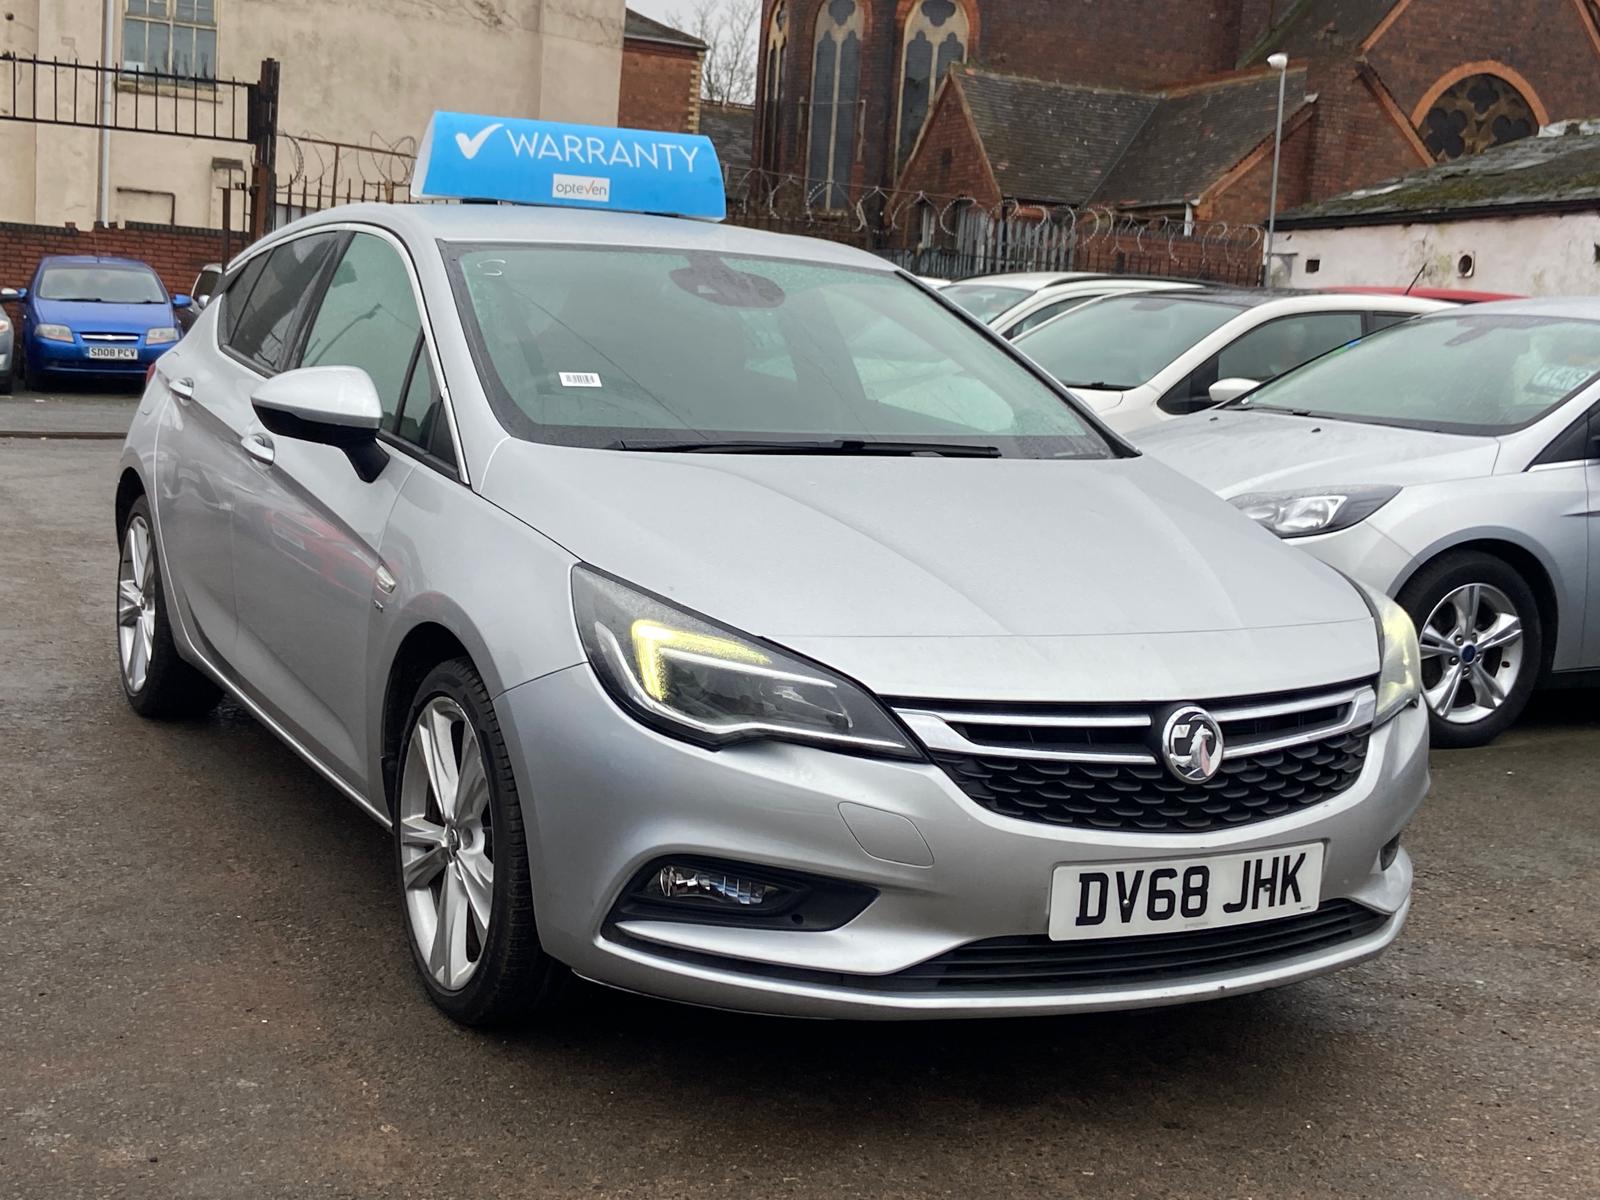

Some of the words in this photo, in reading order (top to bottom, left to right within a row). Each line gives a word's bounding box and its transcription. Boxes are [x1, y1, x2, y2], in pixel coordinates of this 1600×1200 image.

[506, 128, 698, 173] WARRANTY
[555, 179, 607, 196] opteven
[91, 347, 115, 357] SD08
[118, 348, 135, 358] PCV
[1075, 865, 1210, 926] DV68
[1223, 852, 1306, 913] JHK
